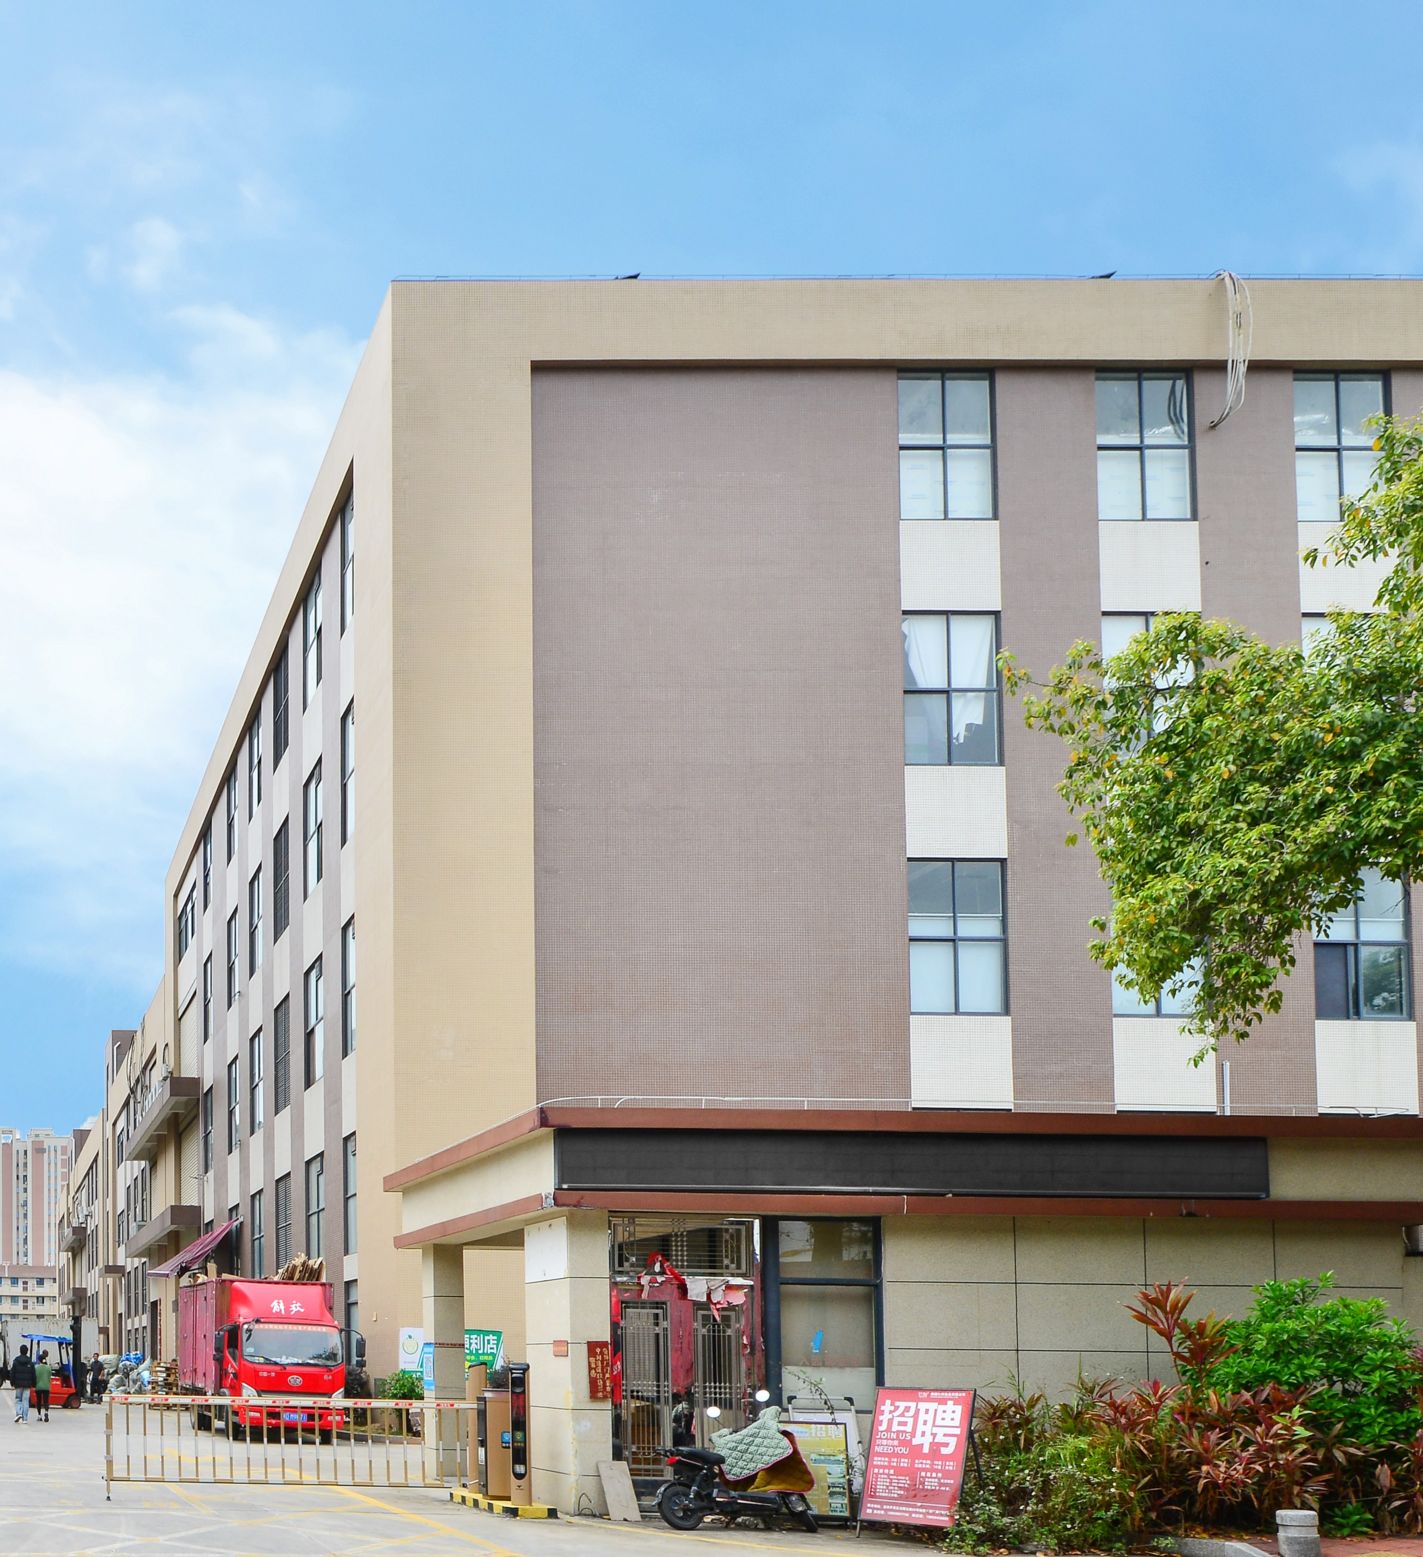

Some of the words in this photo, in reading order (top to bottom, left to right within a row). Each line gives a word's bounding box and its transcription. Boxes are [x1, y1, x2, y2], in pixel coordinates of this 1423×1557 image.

[271, 1300, 304, 1314] 解放
[878, 1400, 962, 1455] 招聘
[876, 1431, 897, 1439] JOIN
[874, 1445, 894, 1454] NEED
[894, 1446, 909, 1454] YOU
